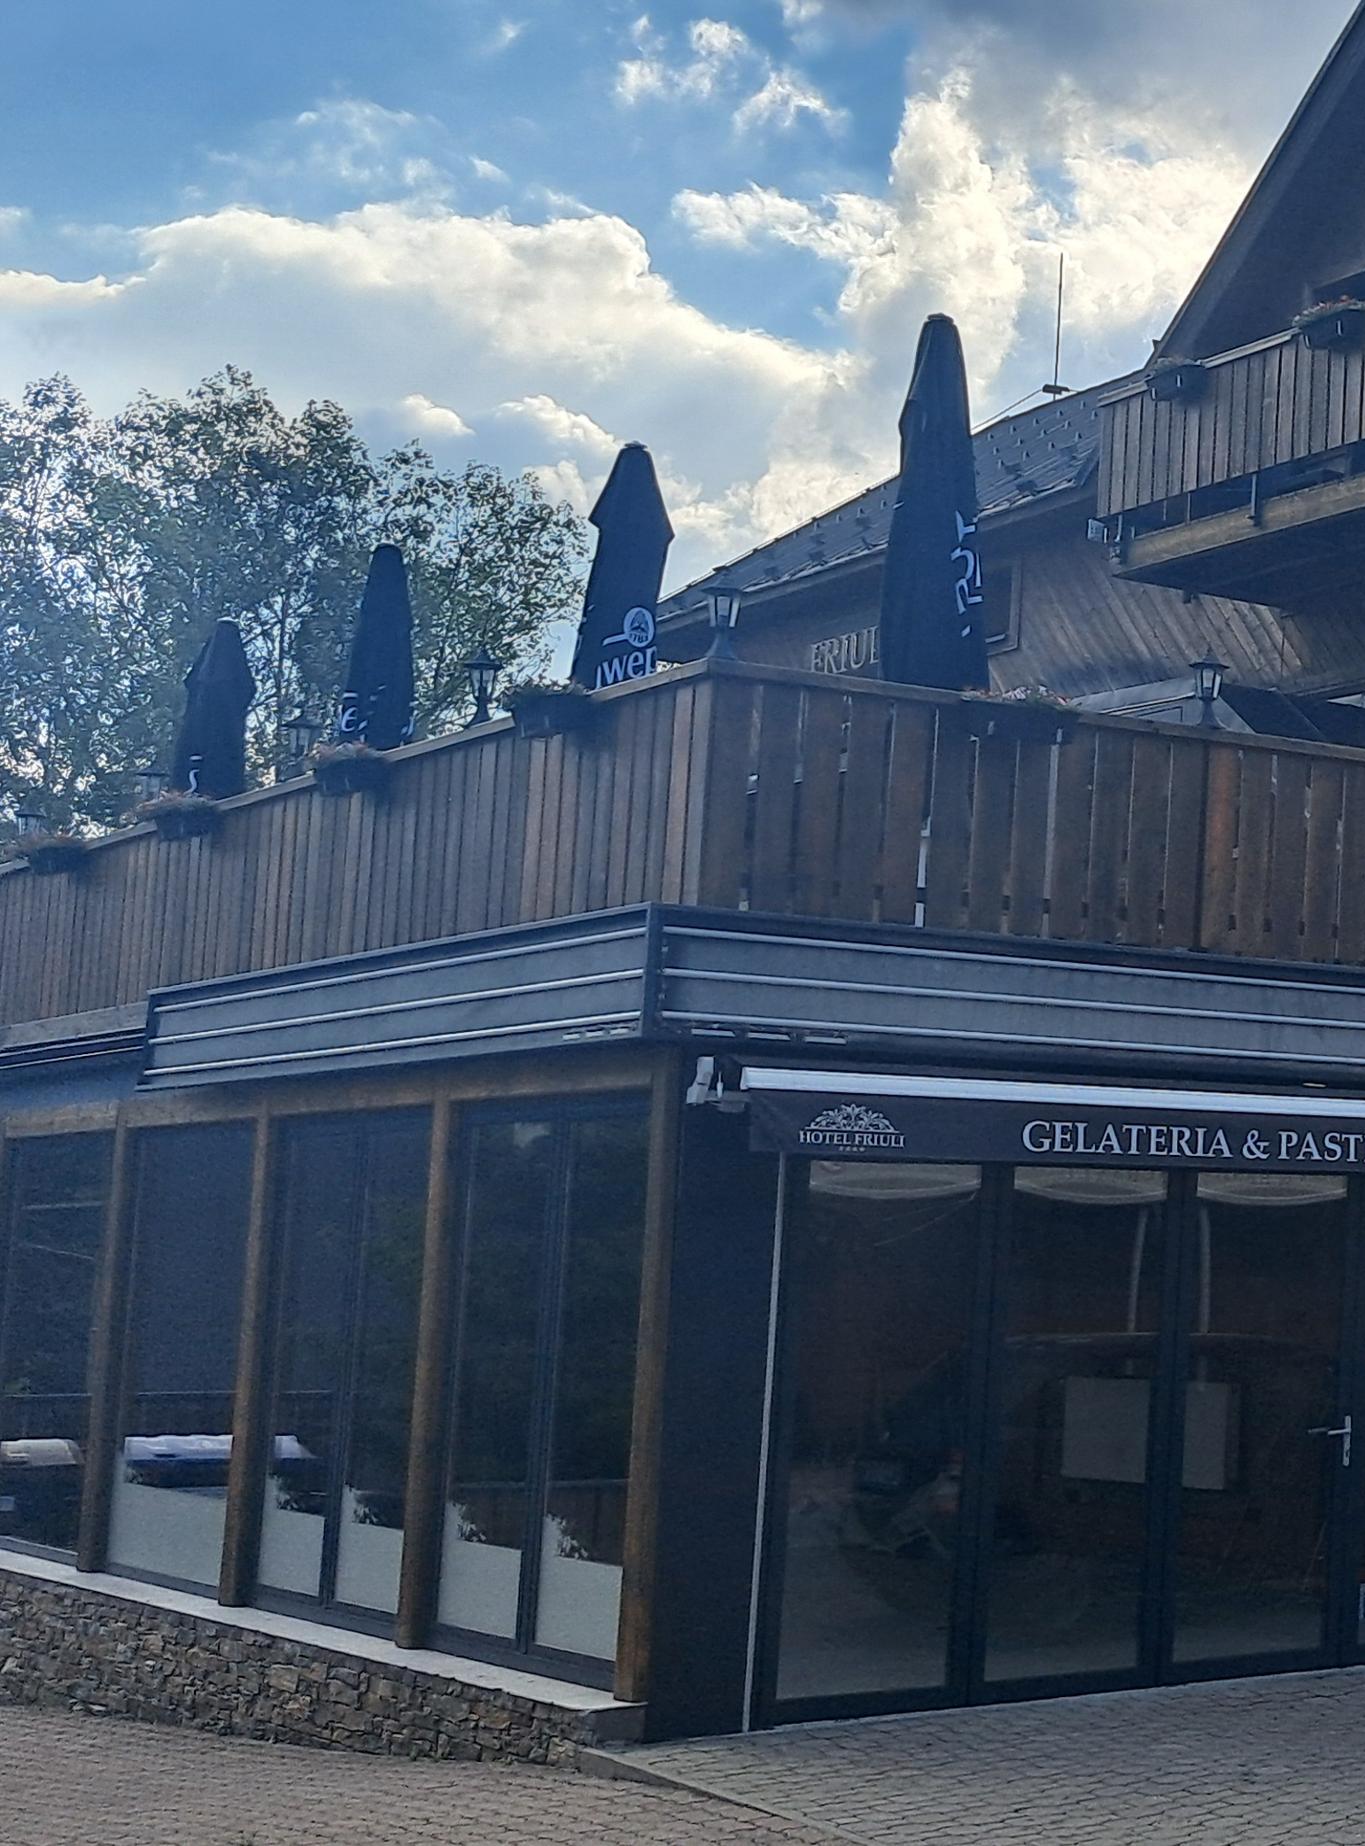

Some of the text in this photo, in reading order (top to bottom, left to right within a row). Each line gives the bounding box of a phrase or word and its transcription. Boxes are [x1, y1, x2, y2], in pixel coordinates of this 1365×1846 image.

[799, 1129, 906, 1149] HOTEL FRIULI
[1021, 1119, 1234, 1158] GELATERIA
[1241, 1129, 1270, 1160] &
